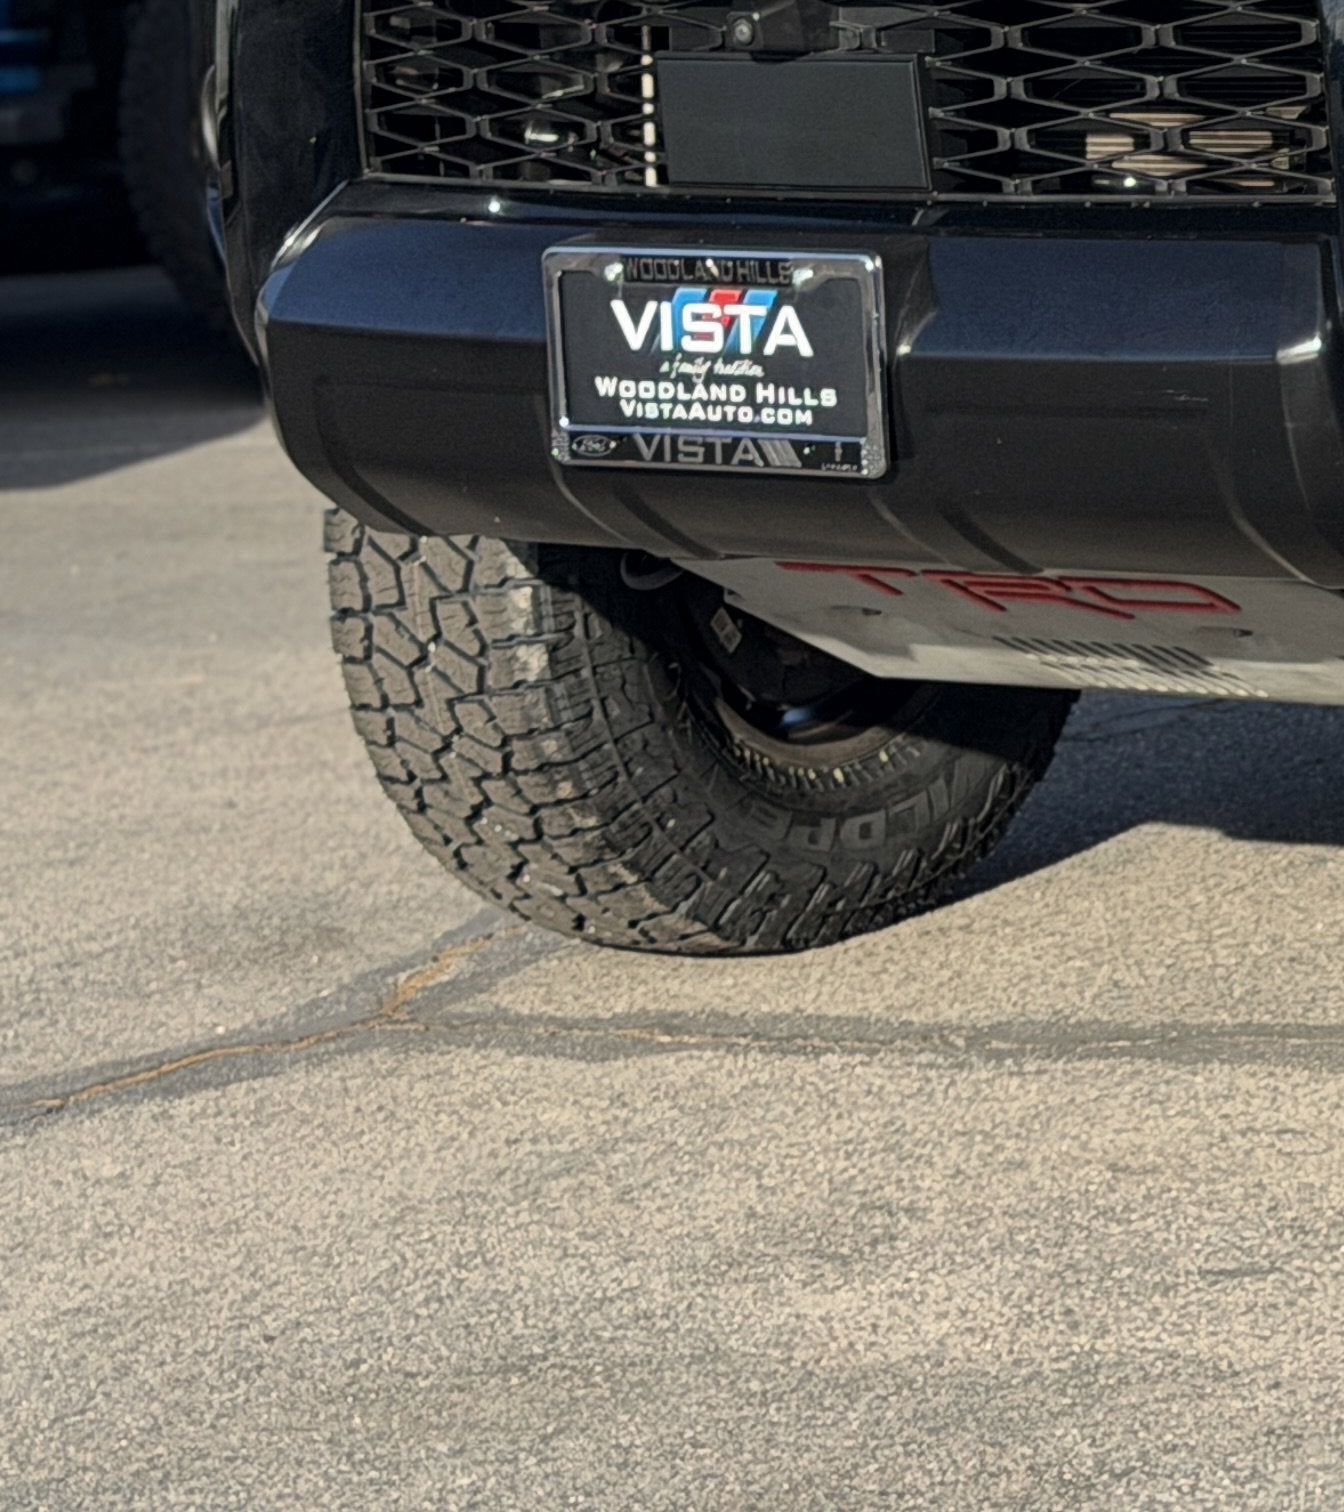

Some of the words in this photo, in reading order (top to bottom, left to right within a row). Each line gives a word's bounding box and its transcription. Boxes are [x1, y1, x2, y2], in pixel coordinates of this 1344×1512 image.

[610, 298, 814, 357] VISTA
[633, 433, 764, 467] VISTA
[775, 561, 1242, 619] TRD
